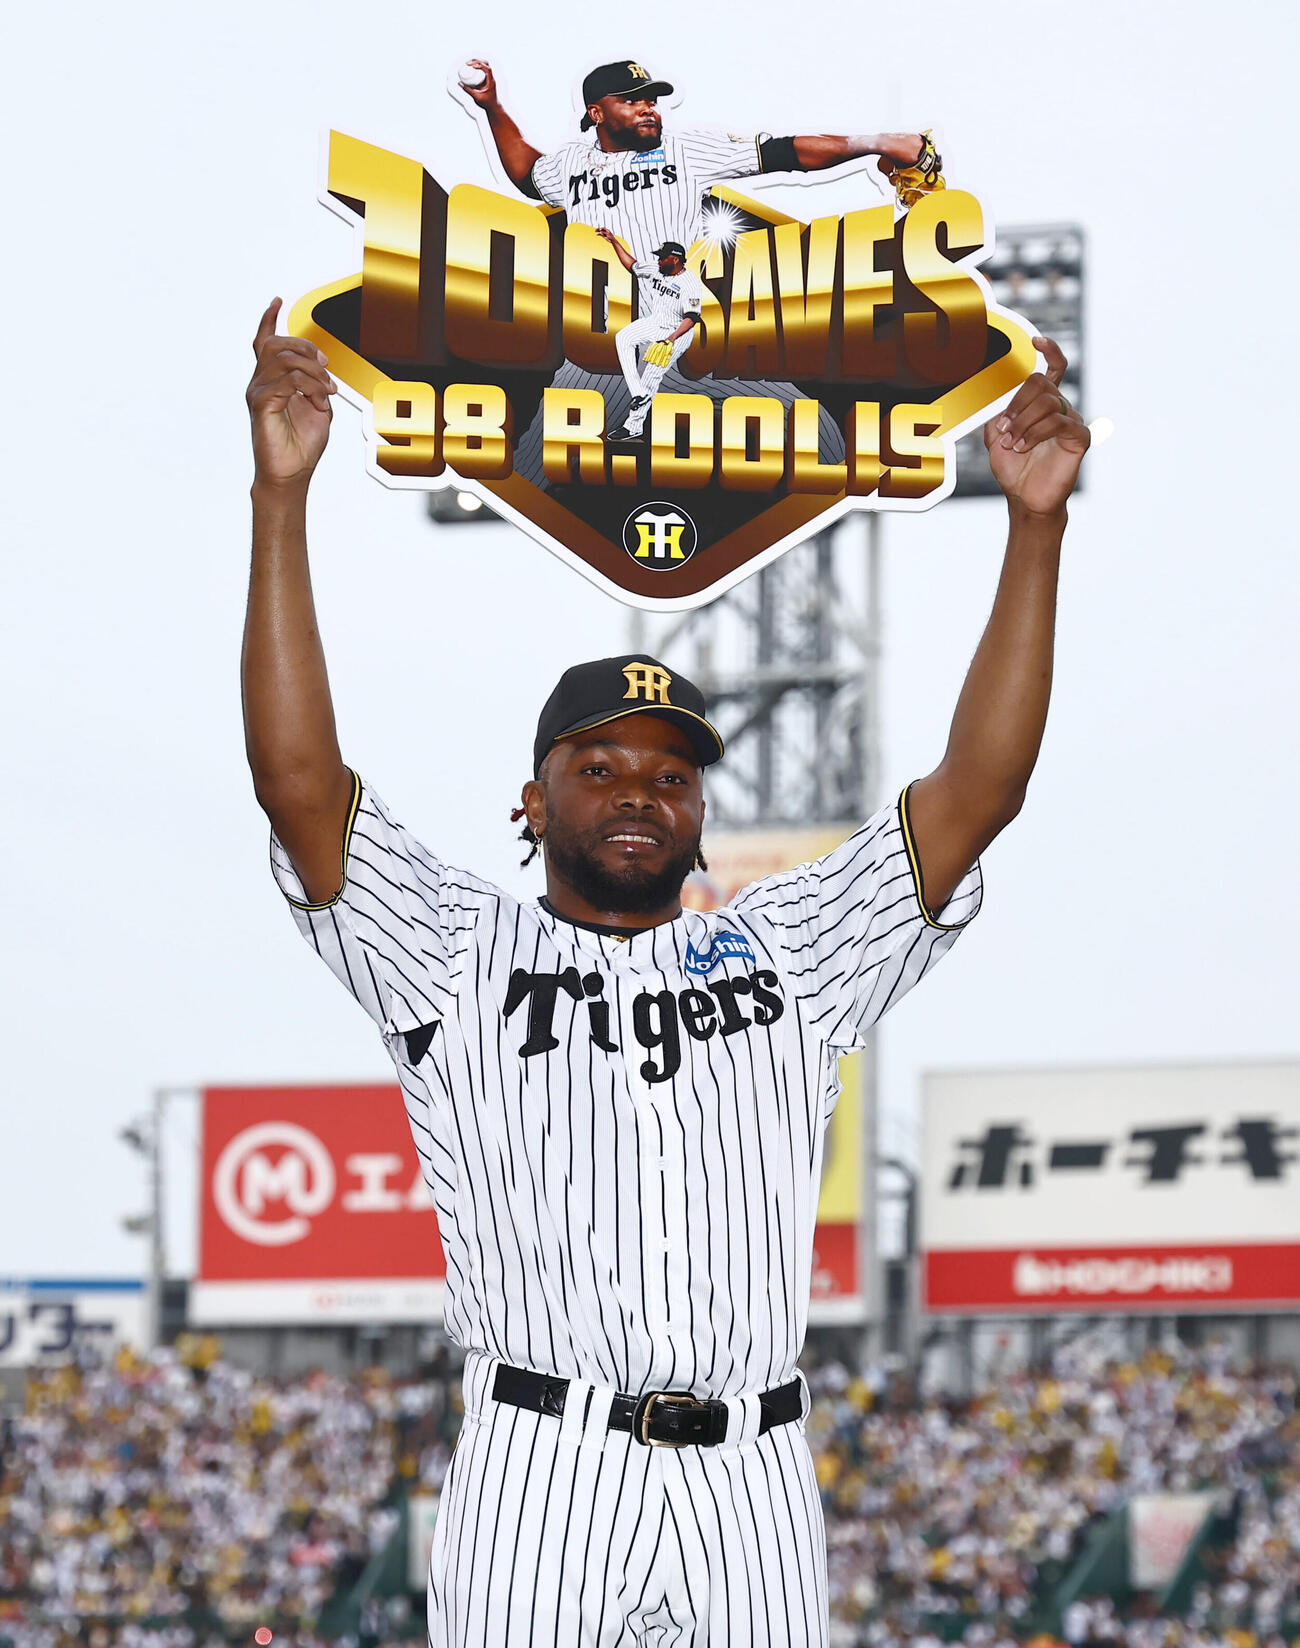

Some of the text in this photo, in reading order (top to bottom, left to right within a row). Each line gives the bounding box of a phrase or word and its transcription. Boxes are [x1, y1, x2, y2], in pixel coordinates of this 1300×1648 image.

[569, 164, 678, 208] Tigers
[327, 129, 988, 390] 100 SAVES
[651, 278, 680, 300] Tigers
[373, 380, 945, 499] 98 R.DOLIS
[686, 938, 753, 971] Joshin
[503, 967, 785, 1083] Tigers
[946, 1112, 1300, 1190] ホーチキ
